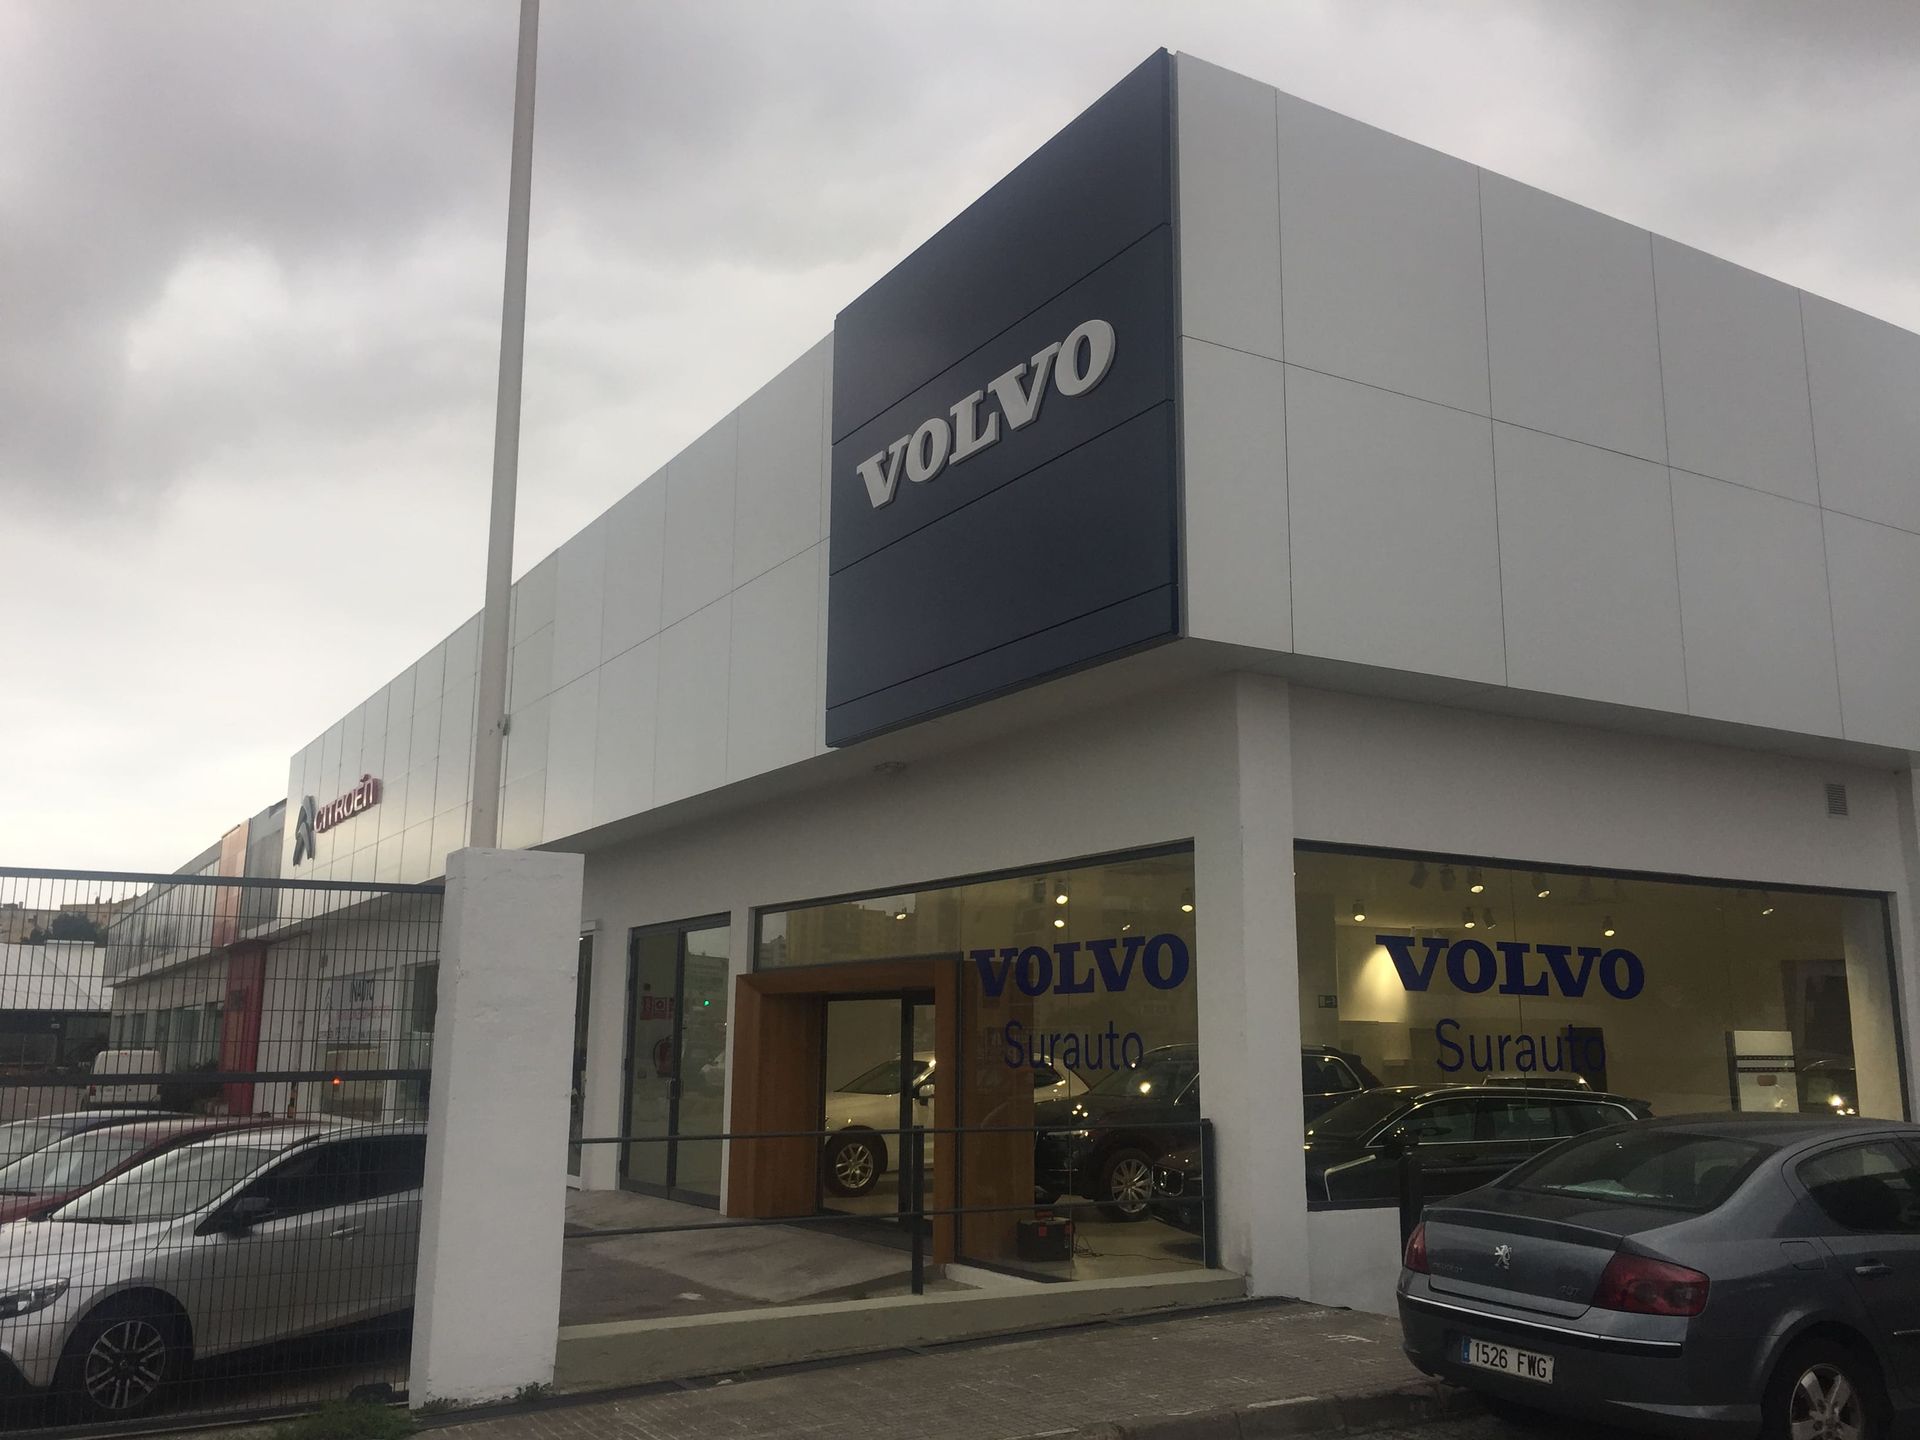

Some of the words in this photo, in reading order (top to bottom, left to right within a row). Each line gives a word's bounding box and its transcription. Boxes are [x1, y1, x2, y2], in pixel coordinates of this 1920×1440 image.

[857, 319, 1115, 508] VOLVO
[970, 933, 1189, 997] VOLVO
[1376, 935, 1644, 999] VOLVO
[1004, 1020, 1143, 1070] Surauto
[1436, 1018, 1605, 1072] Surauto
[1475, 1342, 1508, 1369] 1526
[1517, 1352, 1547, 1378] FWG
